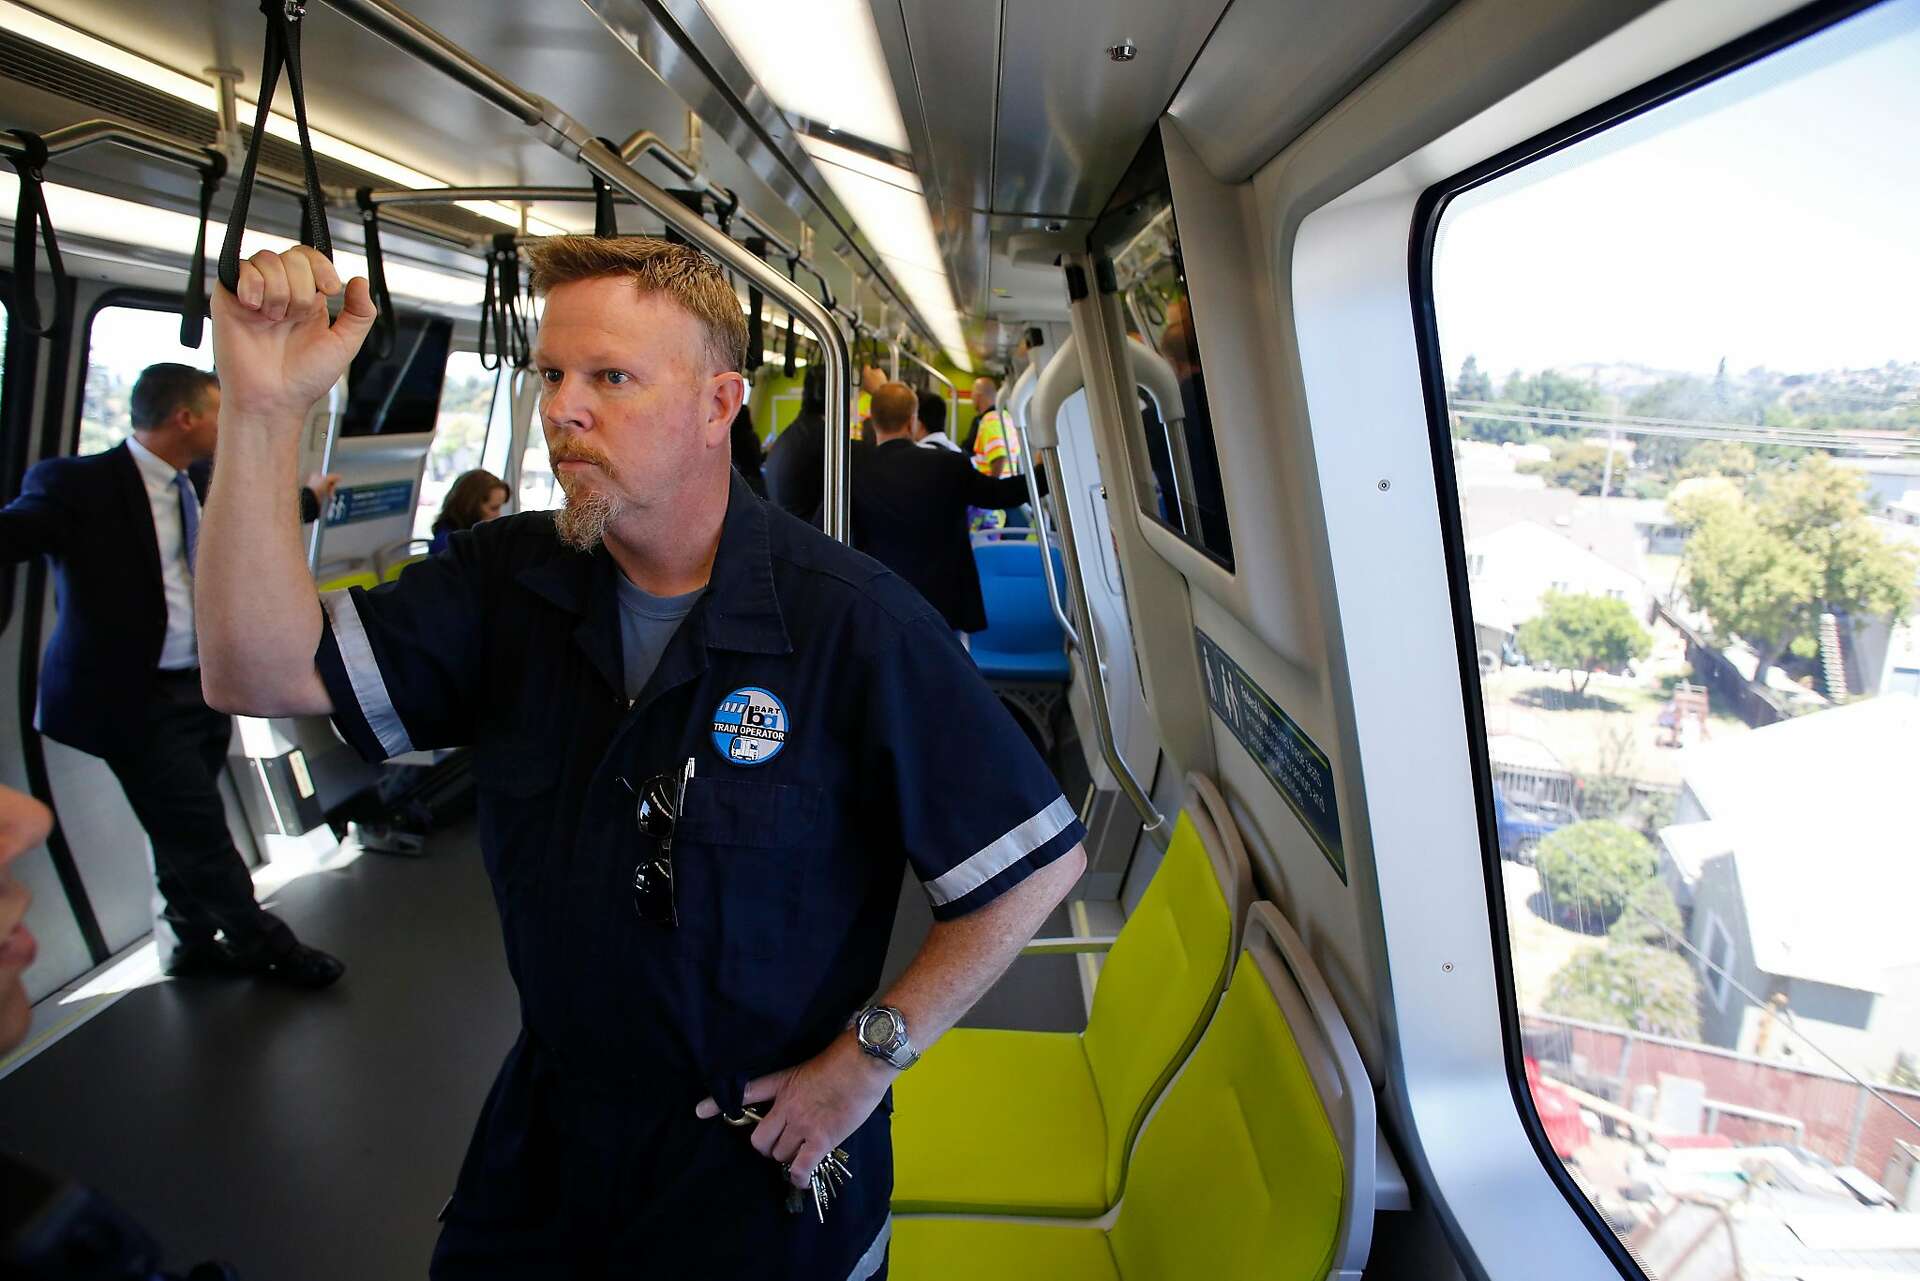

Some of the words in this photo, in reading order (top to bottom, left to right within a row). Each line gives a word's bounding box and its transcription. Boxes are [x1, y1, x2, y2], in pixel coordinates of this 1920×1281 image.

[755, 706, 780, 714] BART
[714, 723, 738, 733] TRAIN
[740, 726, 785, 741] OPERATOR
